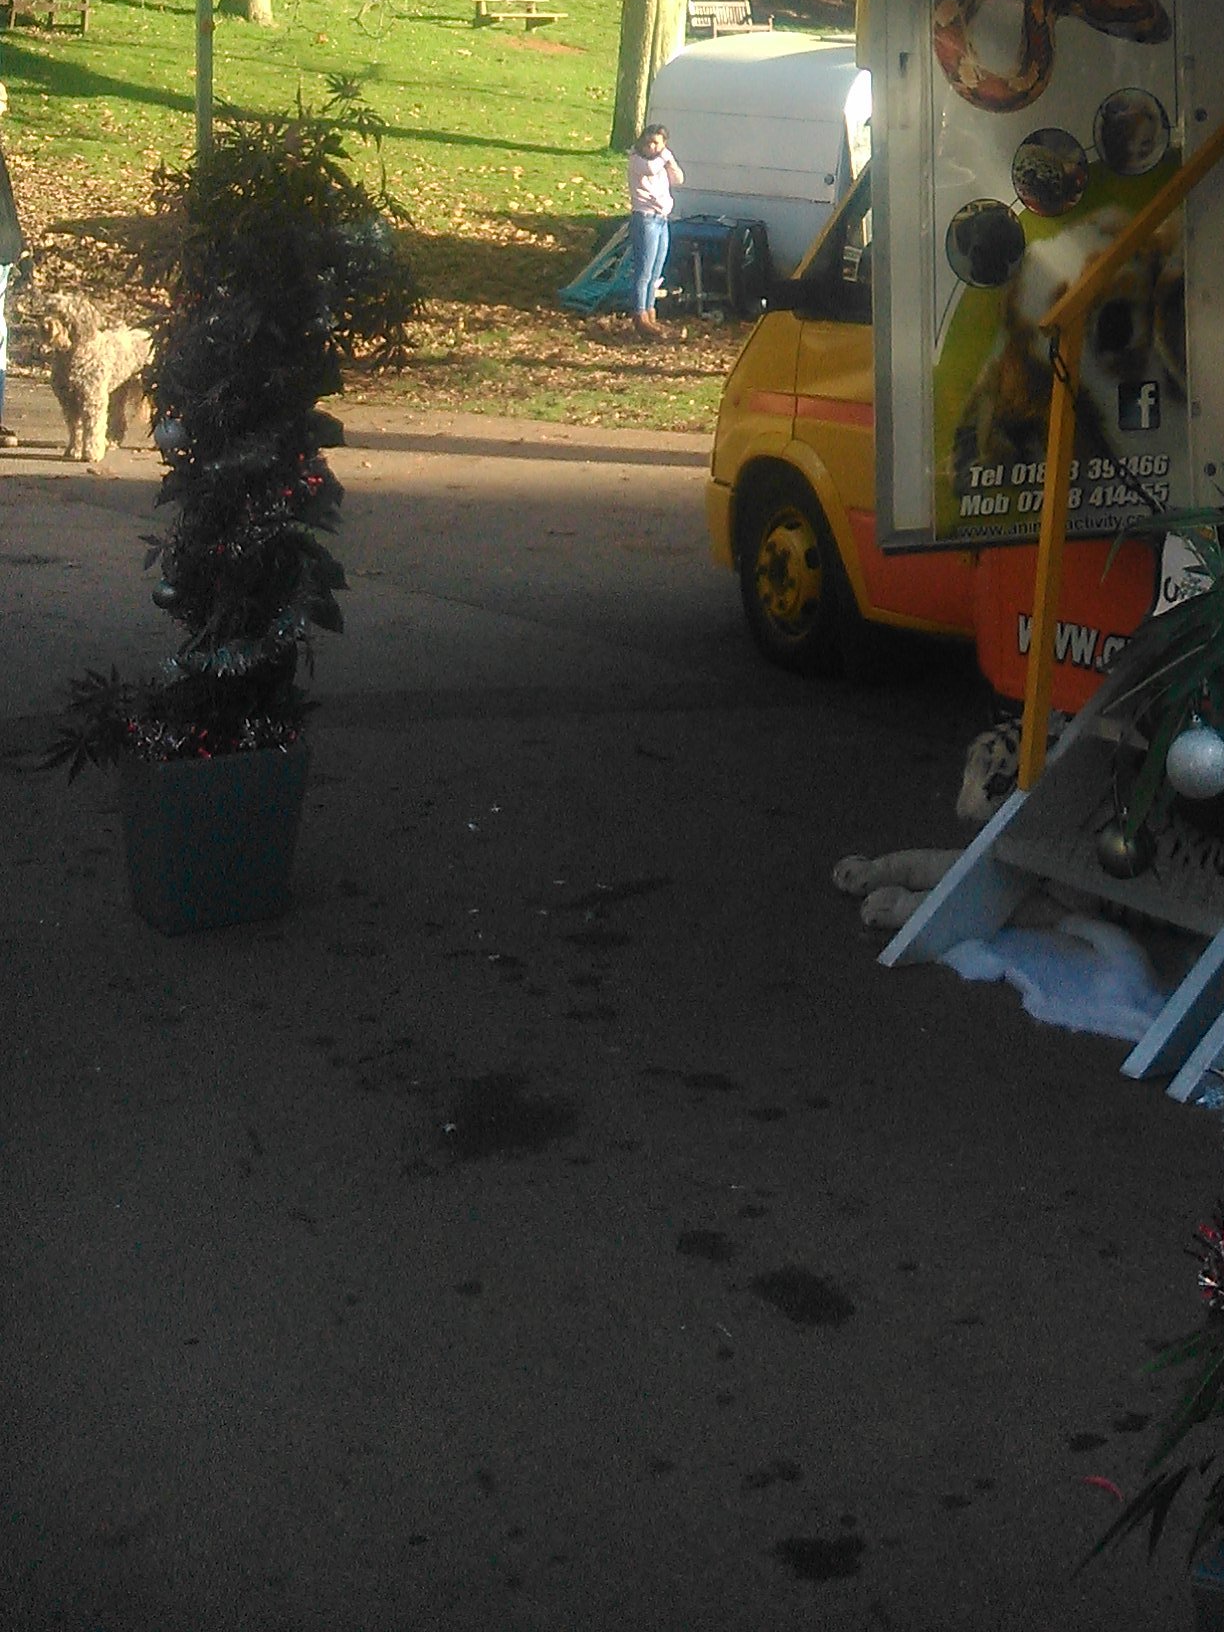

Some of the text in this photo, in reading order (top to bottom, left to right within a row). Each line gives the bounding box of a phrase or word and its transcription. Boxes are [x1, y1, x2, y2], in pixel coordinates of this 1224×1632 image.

[970, 465, 1003, 489] Tel
[1011, 460, 1080, 486] 0183
[959, 494, 1010, 518] Mob
[1017, 488, 1082, 514] 078
